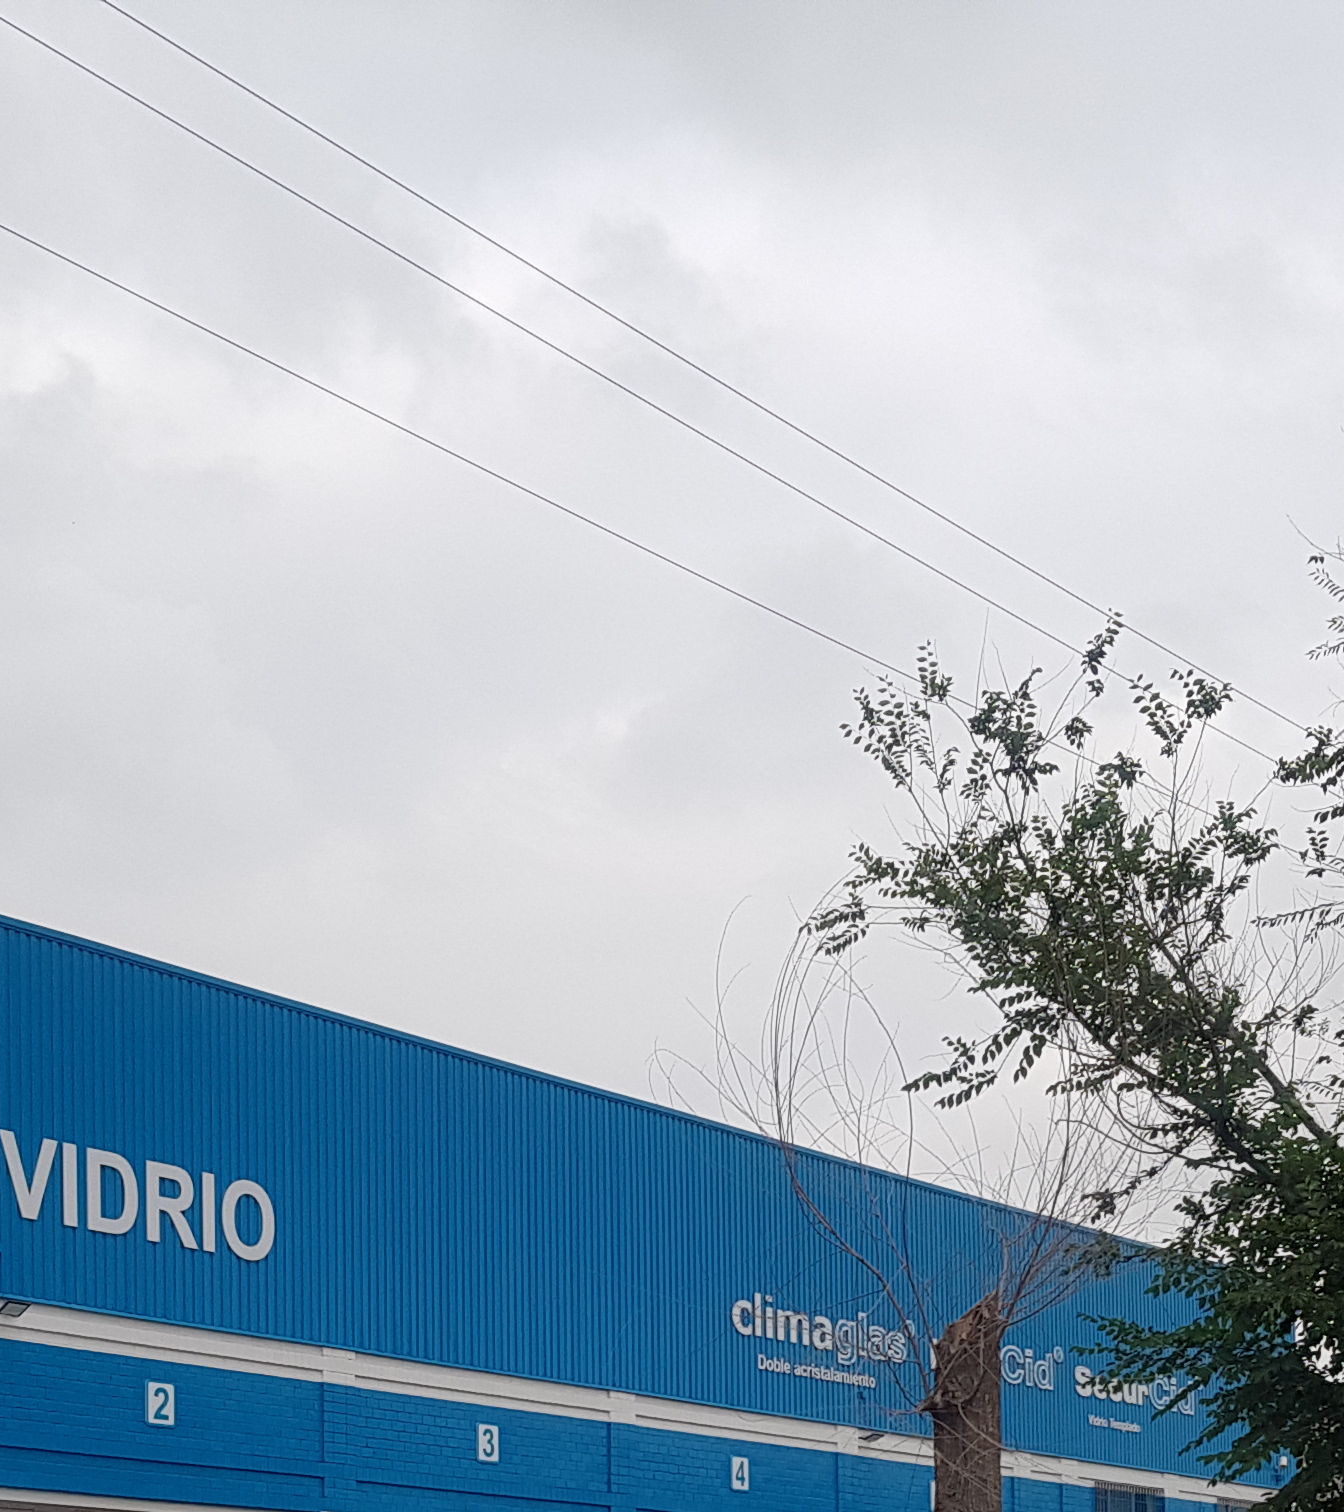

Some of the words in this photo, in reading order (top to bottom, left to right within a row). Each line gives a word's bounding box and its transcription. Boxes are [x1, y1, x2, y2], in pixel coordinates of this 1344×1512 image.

[758, 1353, 791, 1374] Doble
[794, 1363, 876, 1389] acristalamiento
[153, 1386, 170, 1421] 2
[482, 1428, 495, 1458] 3
[735, 1460, 746, 1487] 4
